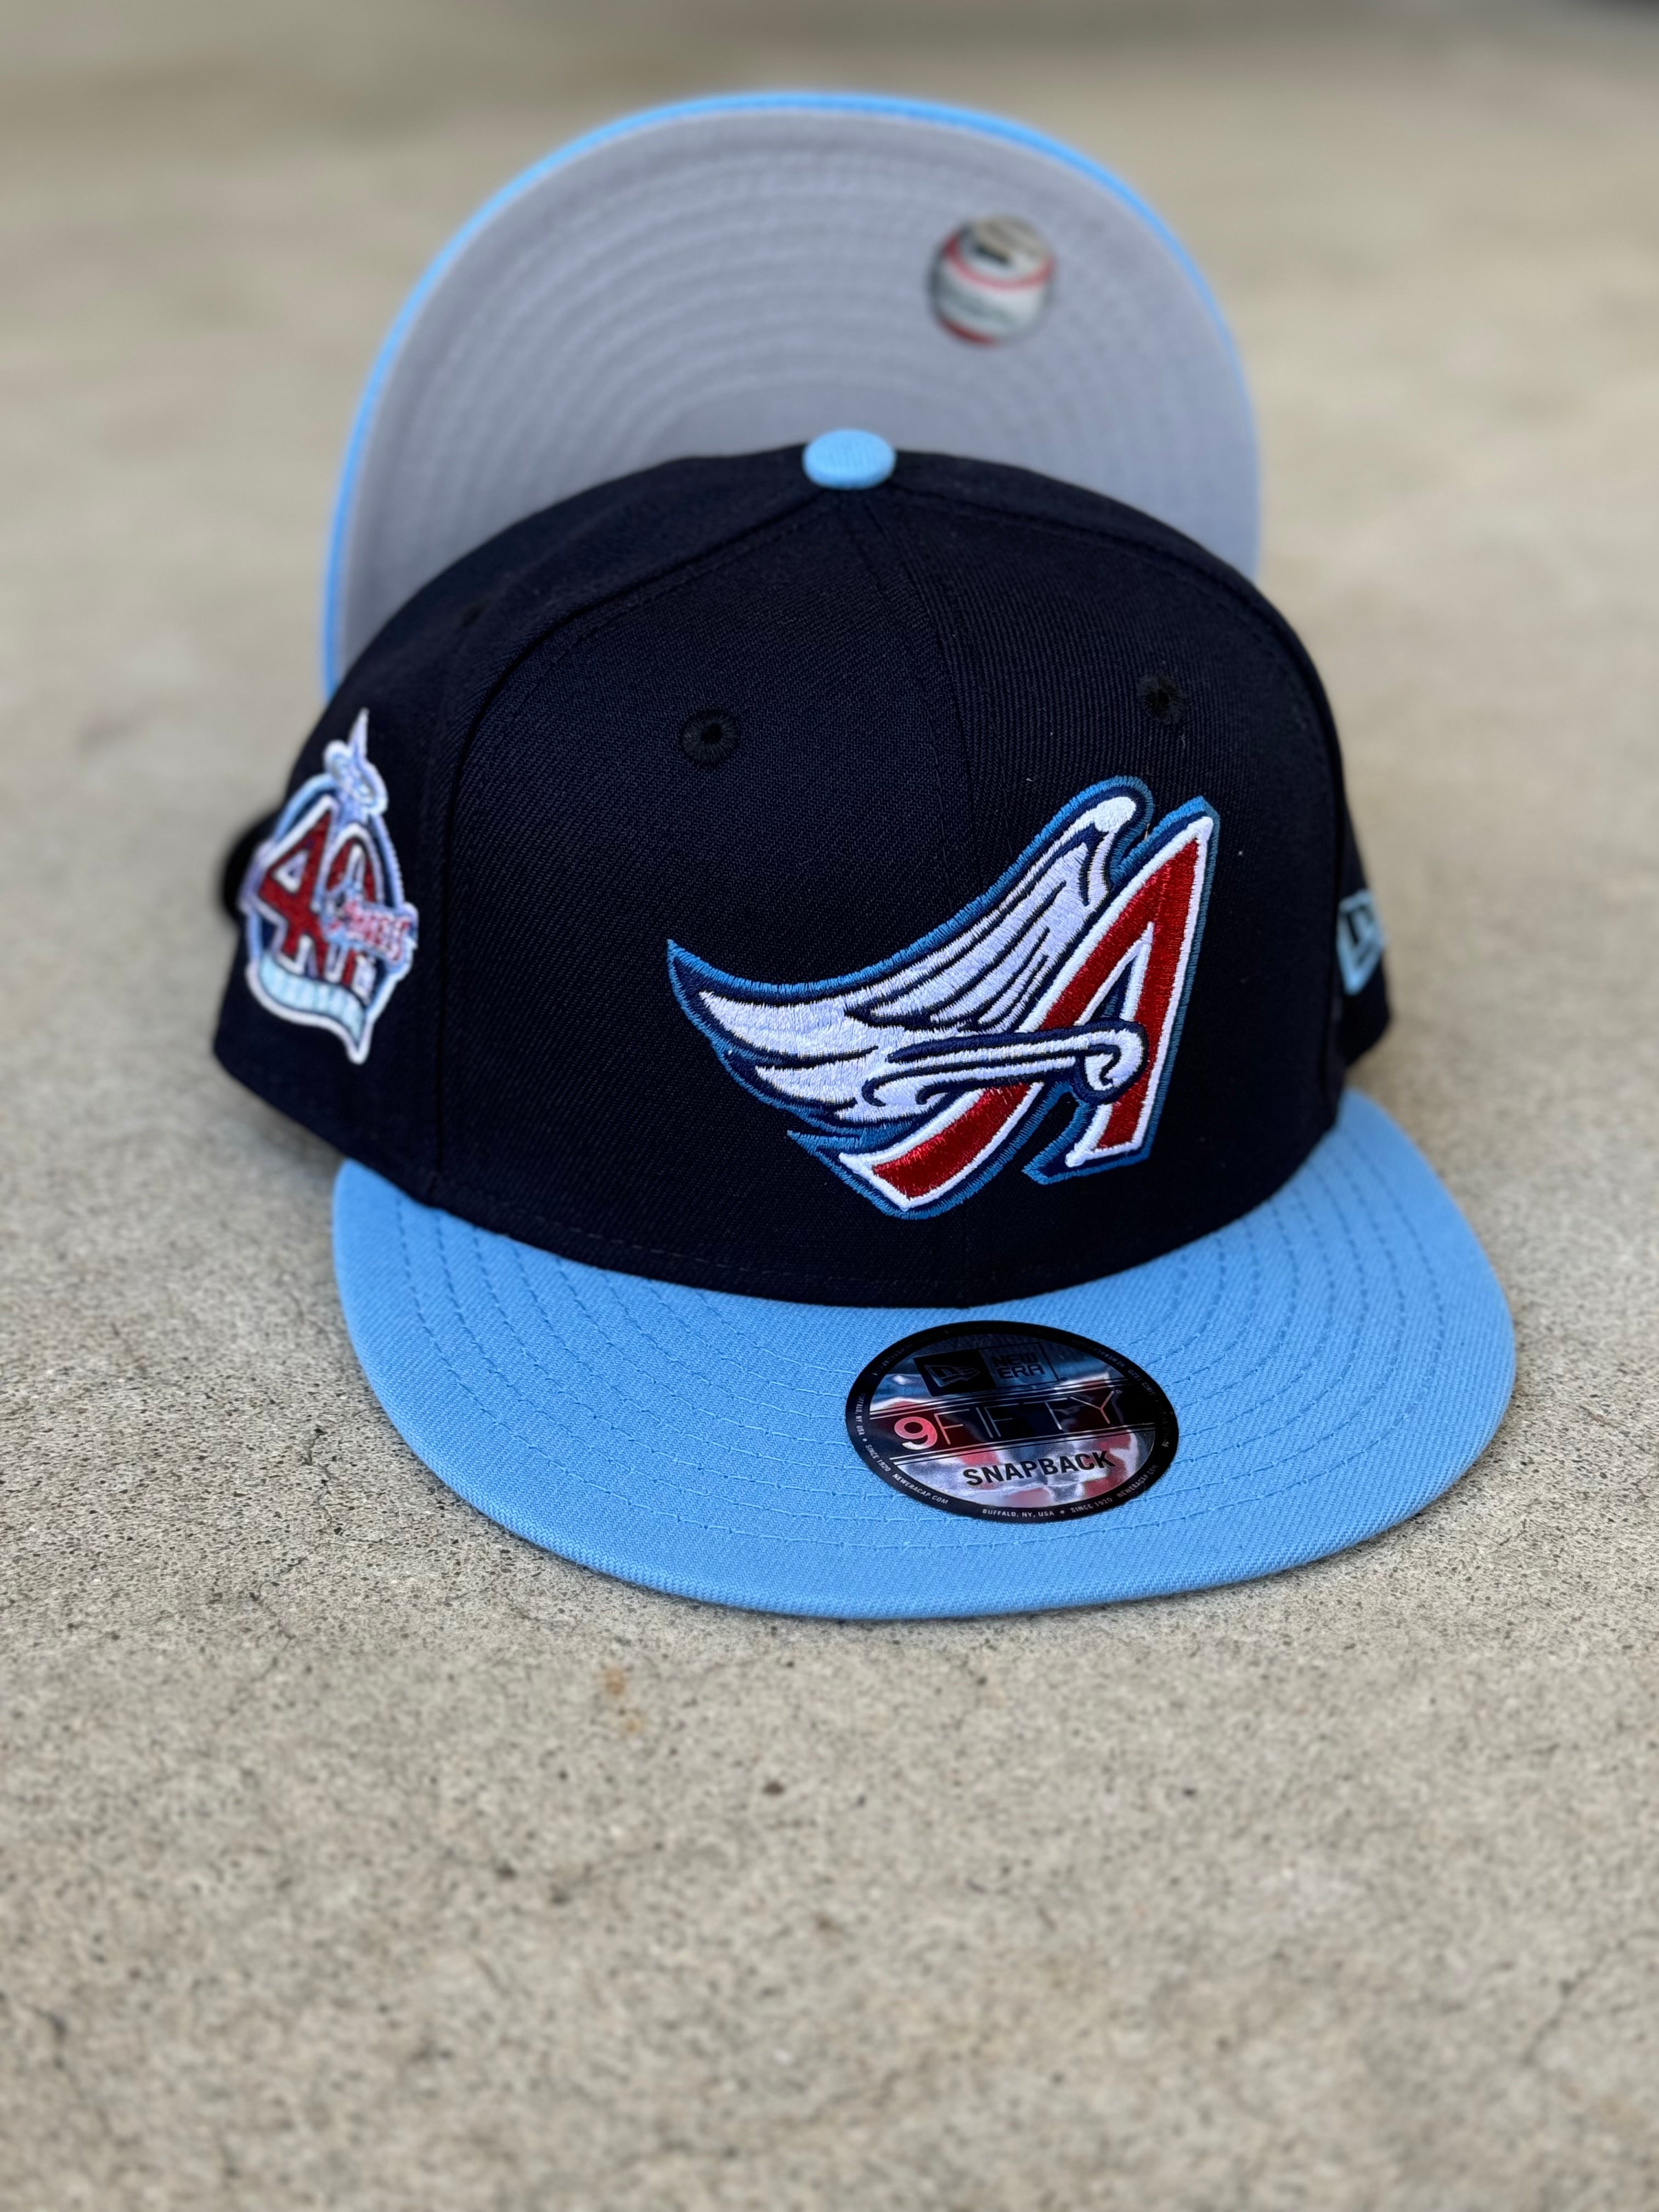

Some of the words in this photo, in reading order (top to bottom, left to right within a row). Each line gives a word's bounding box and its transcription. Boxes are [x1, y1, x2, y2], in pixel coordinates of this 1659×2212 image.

[990, 1351, 1039, 1368] NEW
[996, 1363, 1046, 1380] ERA
[893, 1389, 1115, 1451] 9FIFTY
[865, 1443, 880, 1462] SINCE
[877, 1459, 891, 1472] 1920
[892, 1472, 949, 1505] NEWERACAP.COM
[962, 1450, 1117, 1486] SNAPBACK
[981, 1508, 1019, 1518] BUFFALO,
[1070, 1504, 1093, 1514] SINCE
[1096, 1497, 1114, 1509] 1920
